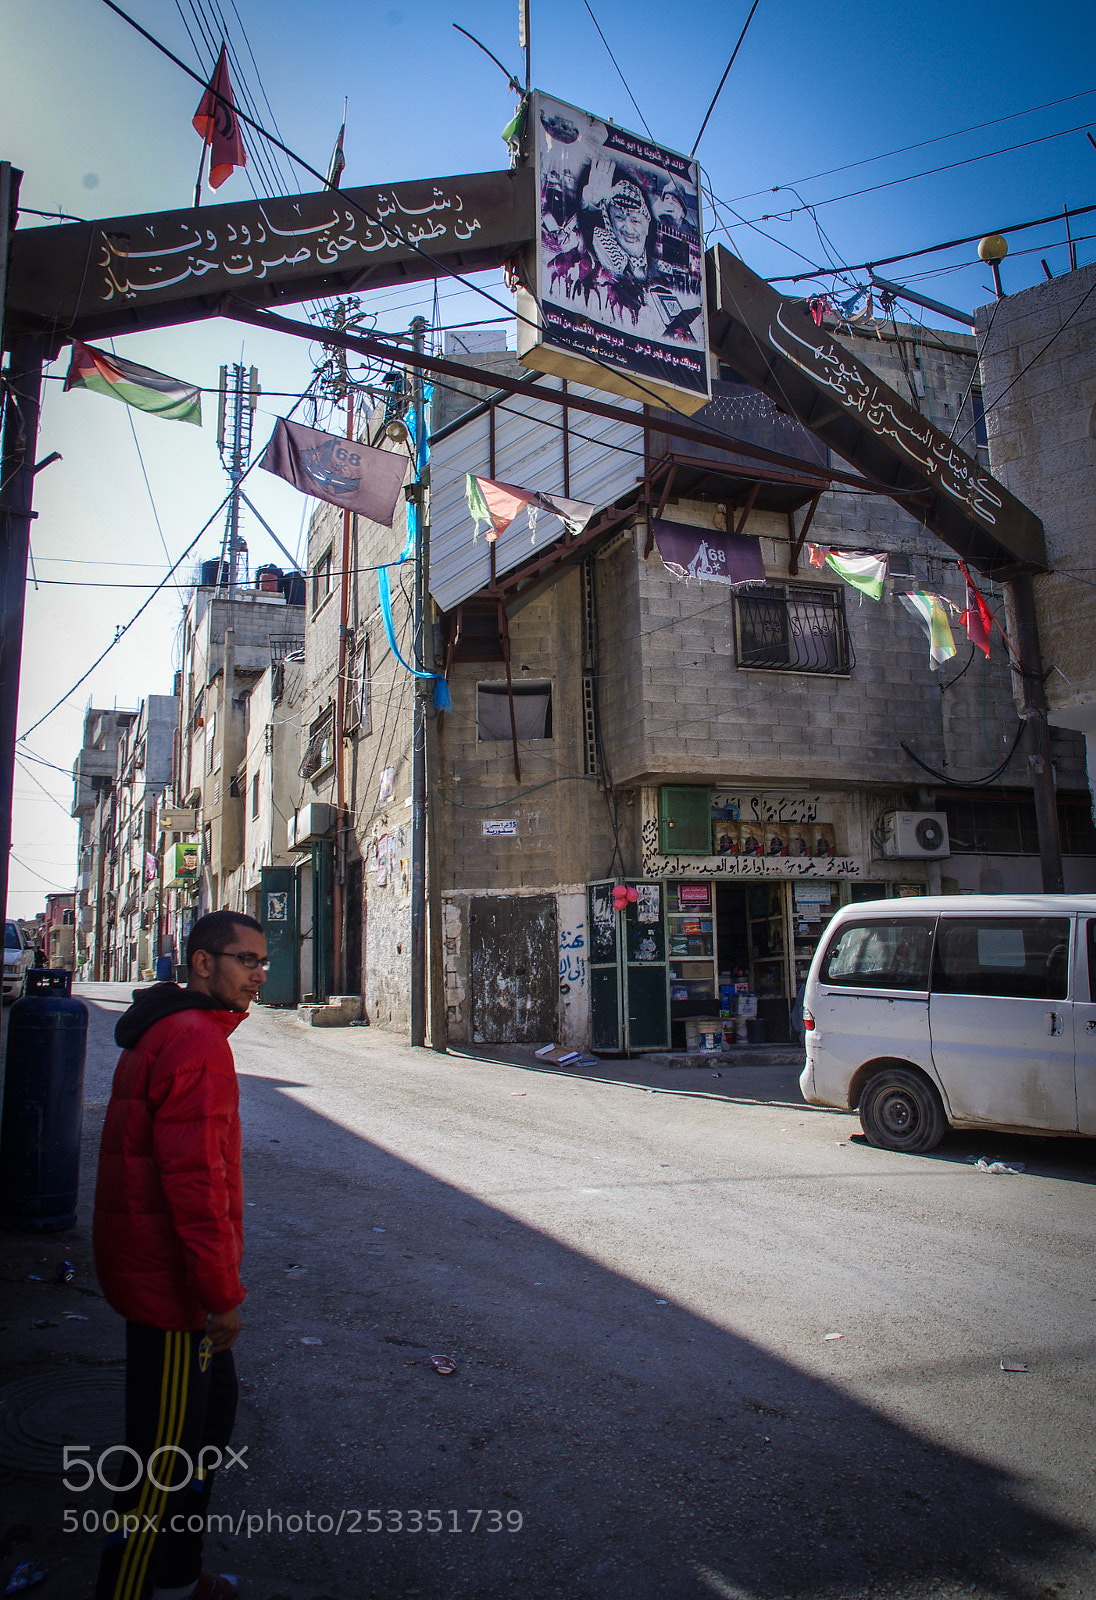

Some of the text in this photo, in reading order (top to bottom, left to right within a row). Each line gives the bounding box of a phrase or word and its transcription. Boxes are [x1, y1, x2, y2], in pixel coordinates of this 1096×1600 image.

[611, 134, 626, 145] عمار
[98, 186, 463, 267] رشاش وبارود ونار
[100, 217, 482, 301] من طفولتك حتى صرت ختيار
[335, 447, 362, 467] 68
[933, 442, 1003, 508] كوفيتك
[708, 548, 726, 563] 68
